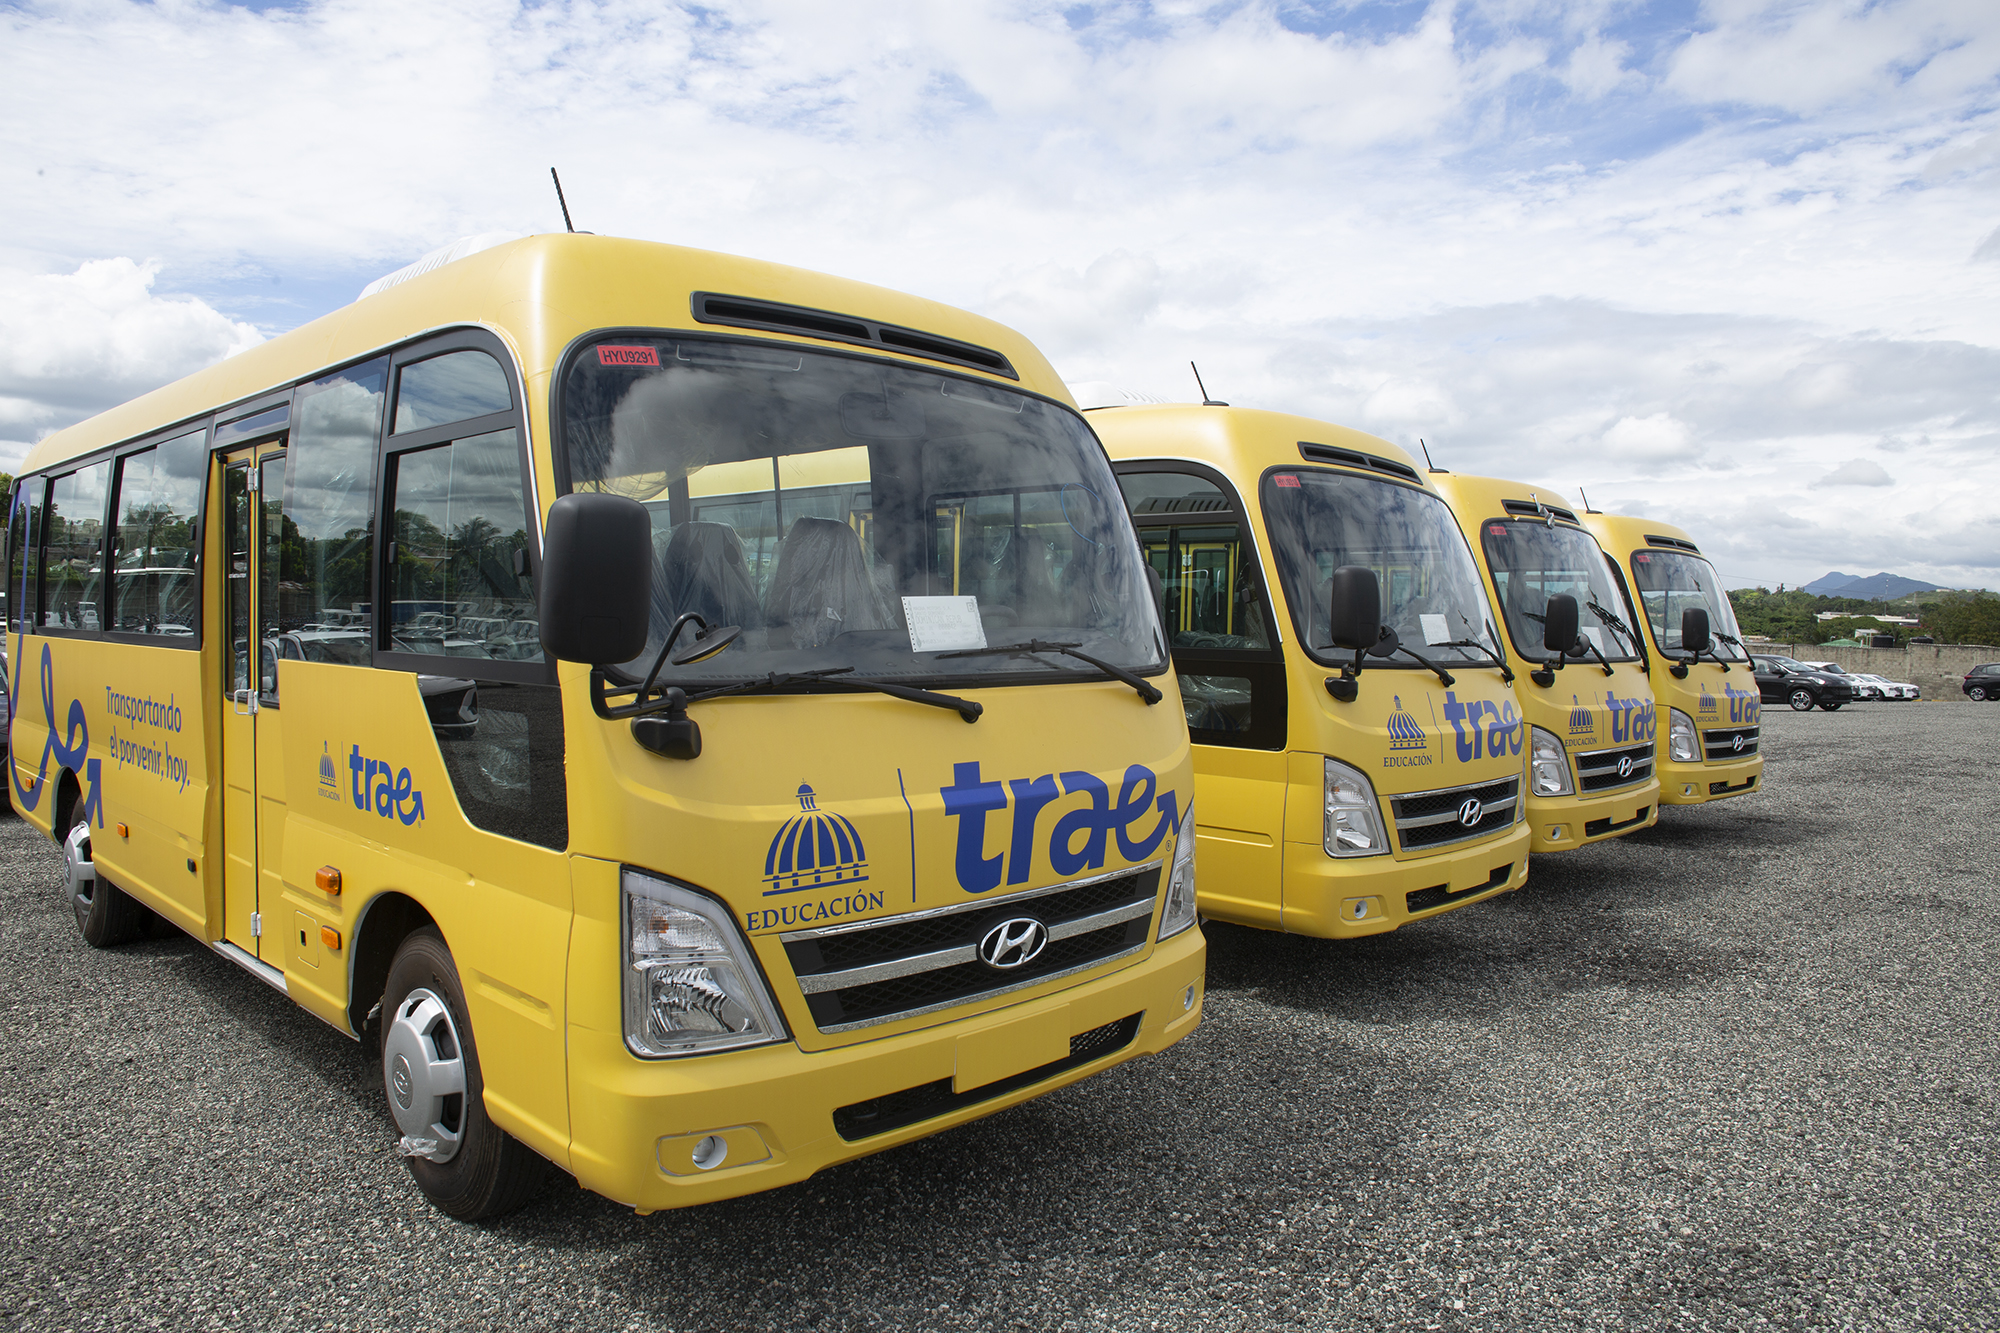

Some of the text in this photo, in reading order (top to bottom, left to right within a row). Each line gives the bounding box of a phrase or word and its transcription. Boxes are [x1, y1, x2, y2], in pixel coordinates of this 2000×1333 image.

[602, 350, 654, 364] HYU9291
[106, 686, 182, 733] Transportando
[1605, 691, 1656, 743] trae
[1724, 682, 1760, 724] trae
[1443, 691, 1523, 763] trae
[1565, 735, 1597, 747] EDUCACIÓN
[110, 725, 190, 795] el porvenir, hoy.
[1383, 753, 1432, 767] EDUCACIÓN
[349, 743, 425, 826] trae
[940, 761, 1180, 894] trae
[746, 888, 885, 932] EDUCACIÓN
